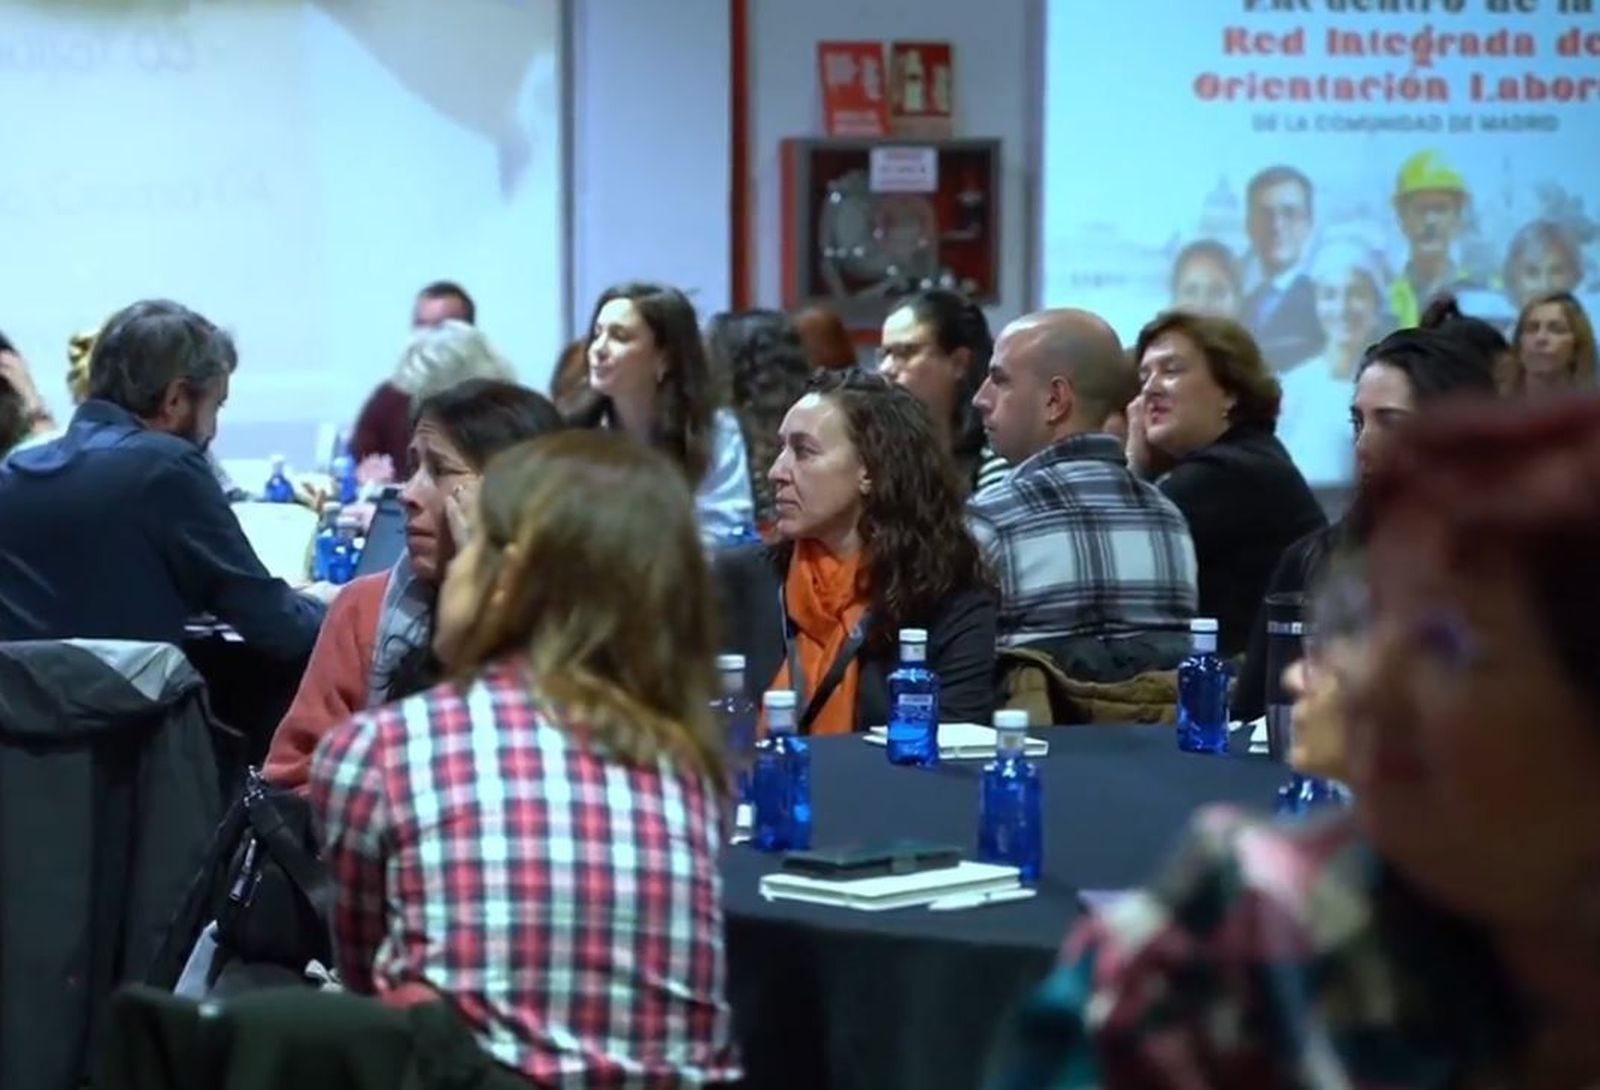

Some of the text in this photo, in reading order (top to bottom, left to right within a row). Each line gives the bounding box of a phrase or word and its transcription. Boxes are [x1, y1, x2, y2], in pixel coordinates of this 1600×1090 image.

[1223, 26, 1304, 56] Red
[1326, 24, 1535, 67] Integrada
[1193, 67, 1600, 101] Orientación Labor
